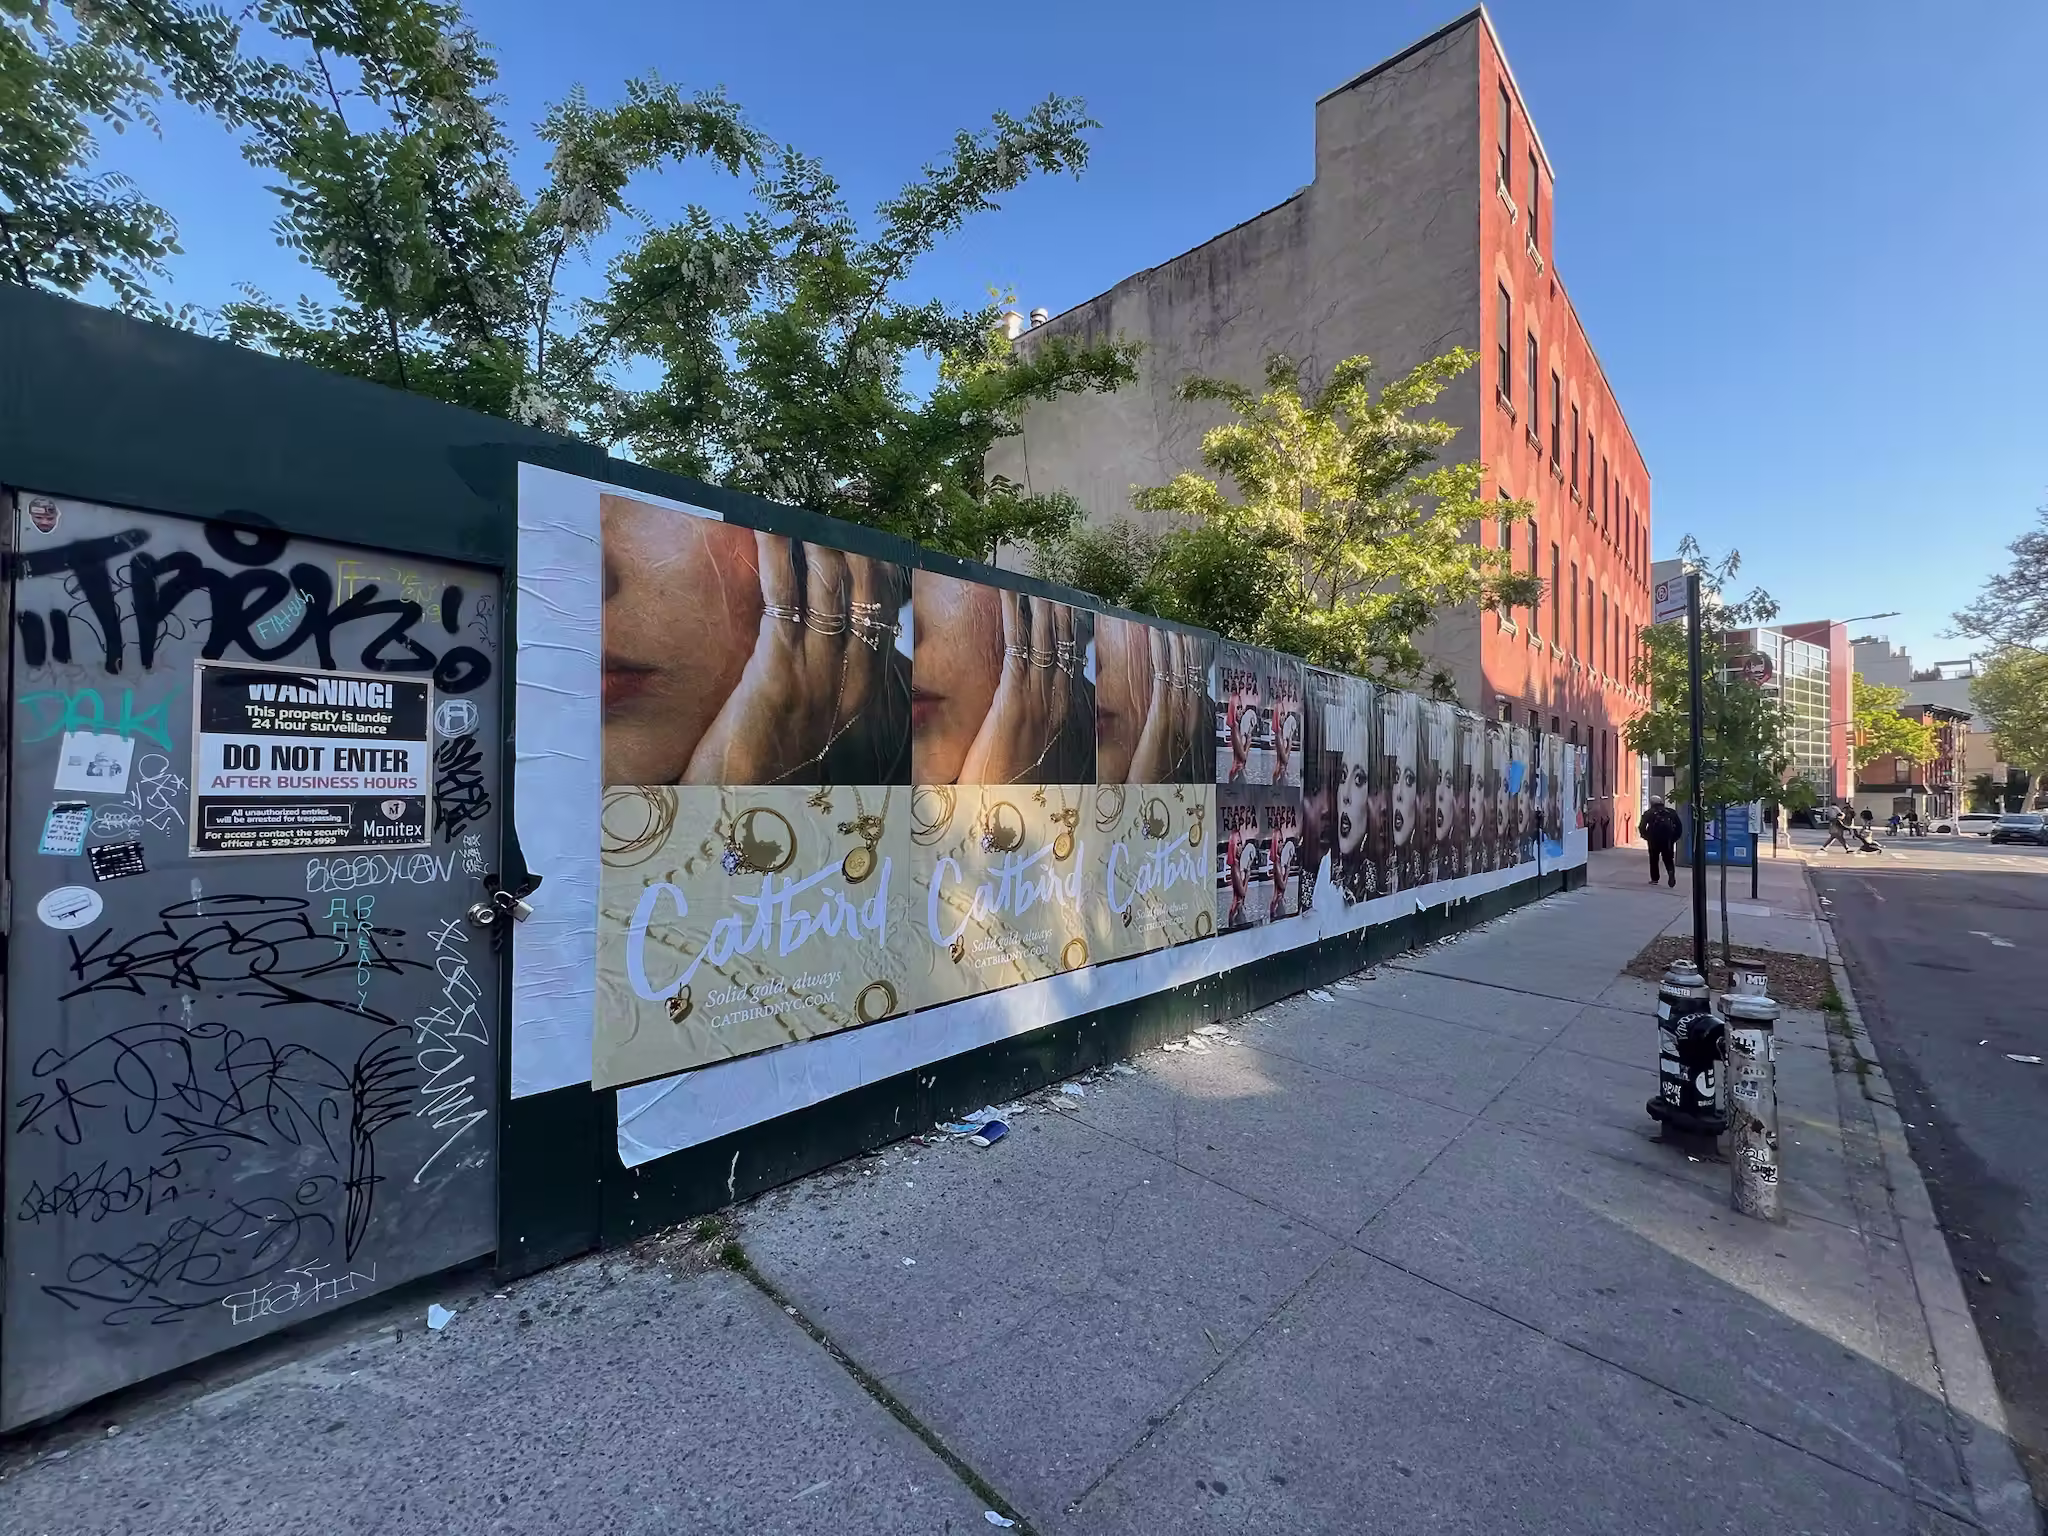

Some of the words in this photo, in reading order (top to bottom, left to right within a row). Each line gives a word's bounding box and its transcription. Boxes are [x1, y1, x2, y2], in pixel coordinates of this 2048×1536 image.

[245, 705, 276, 717] This
[279, 708, 340, 722] property
[342, 710, 352, 721] is
[356, 712, 392, 724] under
[252, 718, 271, 728] 24
[274, 719, 307, 730] hour
[310, 721, 387, 734] surveillance
[223, 744, 260, 770] DO
[271, 745, 325, 772] NOT
[334, 747, 408, 772] ENTER
[211, 776, 271, 788] AFTER
[278, 776, 358, 788] BUSINESS
[364, 777, 417, 788] HOURS
[245, 808, 300, 816] unauthorized
[1220, 805, 1256, 818] TRAPPA
[1265, 805, 1296, 816] TRAPPA
[216, 816, 232, 824] will
[296, 814, 342, 823] trespassing
[1224, 816, 1258, 831] RAPPA
[1268, 816, 1296, 829] RAPPA
[205, 832, 222, 840] For
[258, 830, 294, 838] contact
[314, 828, 350, 838] security
[364, 820, 422, 837] Monitex
[221, 840, 254, 848] officer
[256, 839, 270, 847] at:
[272, 837, 336, 846] 929-279.4999
[1107, 829, 1210, 913] Catbird
[928, 841, 1084, 947] Catbird
[626, 857, 892, 1000] Catbird
[972, 936, 998, 952] Solid
[998, 931, 1020, 952] gold,
[1022, 928, 1053, 943] always
[975, 944, 1048, 968] CATBIRDNYC.COM
[705, 983, 749, 1008] Solid
[749, 976, 788, 1004] gold,
[792, 971, 841, 988] always
[711, 992, 835, 1028] CATBIRDNYC.COM
